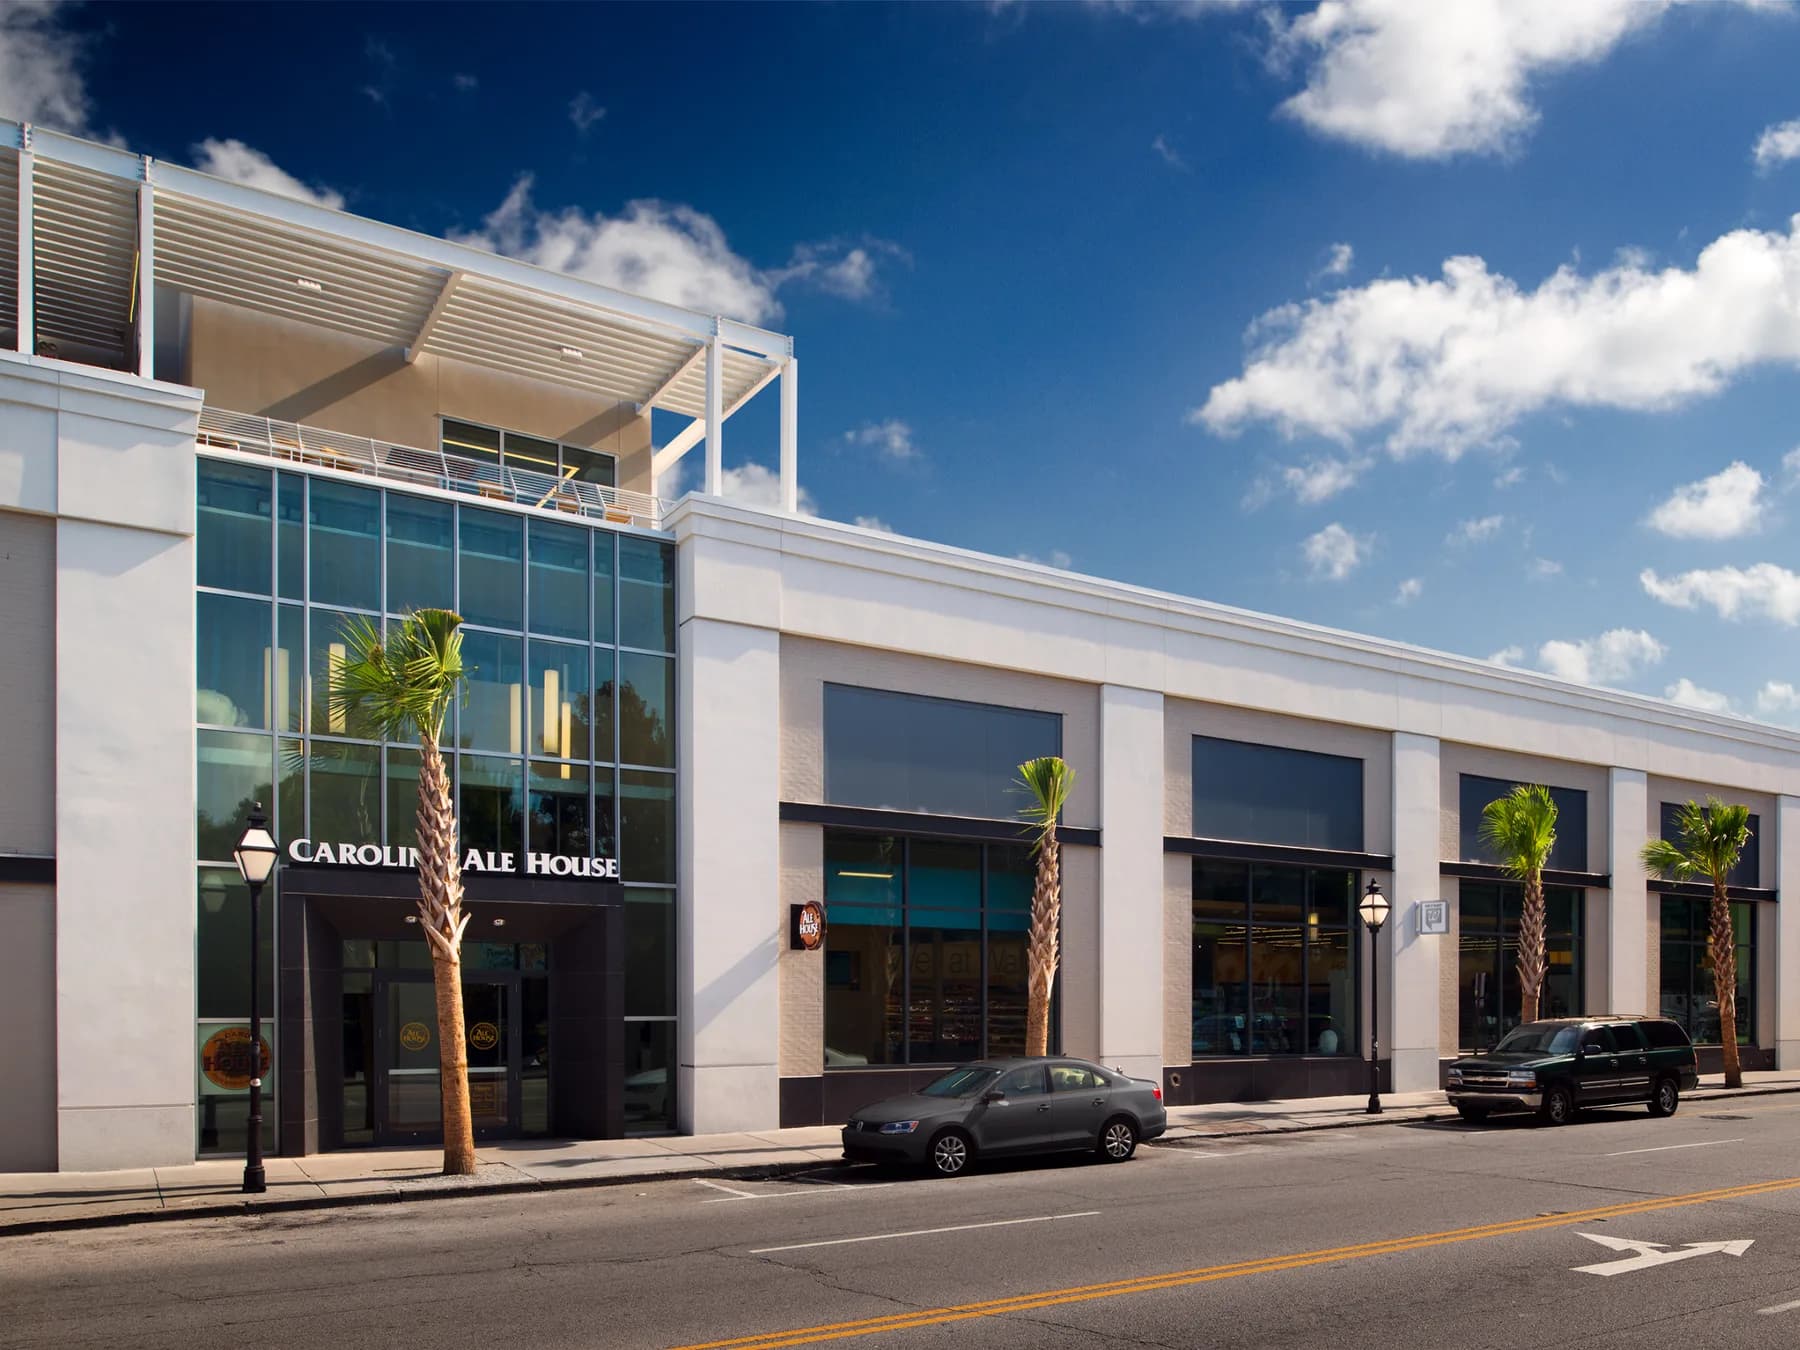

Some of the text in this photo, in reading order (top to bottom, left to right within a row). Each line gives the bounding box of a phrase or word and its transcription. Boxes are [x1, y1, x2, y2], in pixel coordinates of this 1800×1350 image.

[288, 838, 619, 878] CAROLIN ALE HOUSE
[802, 910, 814, 924] ALE
